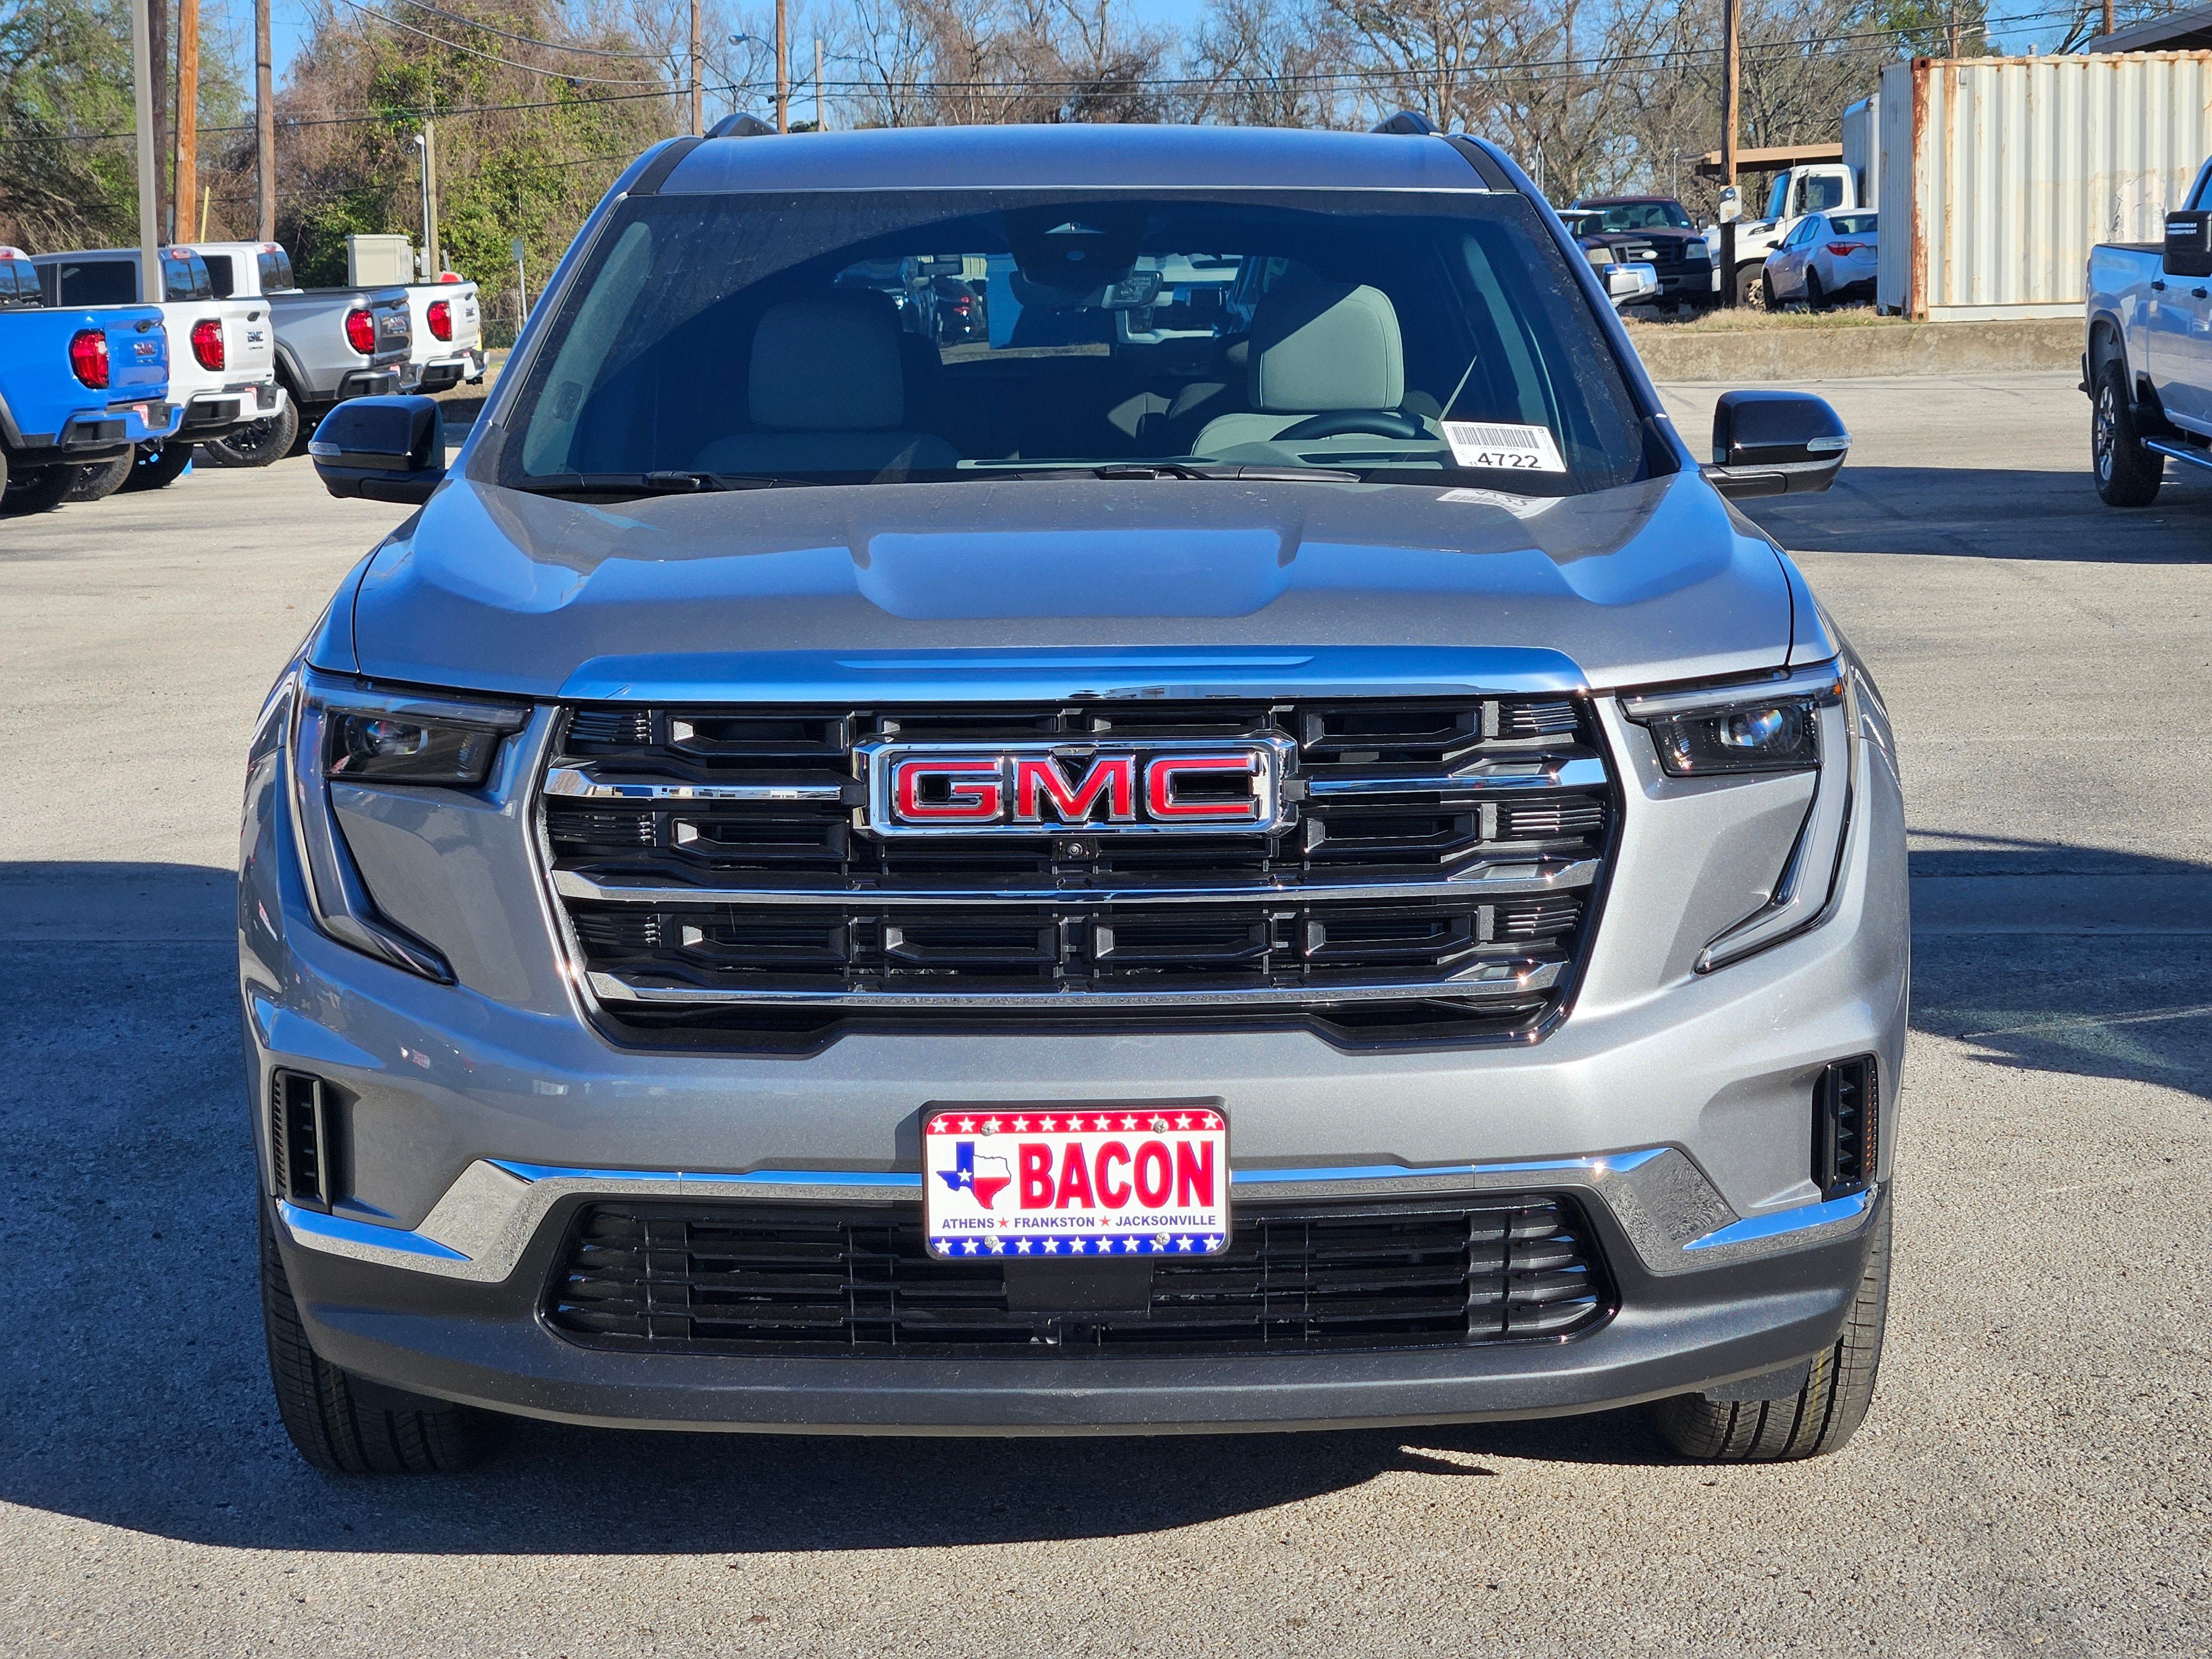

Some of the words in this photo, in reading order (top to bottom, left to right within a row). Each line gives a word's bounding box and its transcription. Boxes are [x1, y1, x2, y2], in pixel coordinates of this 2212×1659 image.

[1478, 452, 1542, 469] 4722
[891, 754, 1260, 823] GMC
[1018, 1140, 1214, 1209] BACON
[942, 1218, 994, 1229] ATHENS
[1014, 1216, 1095, 1228] FRANKSTON
[1115, 1215, 1216, 1227] JACKSONVILLE
